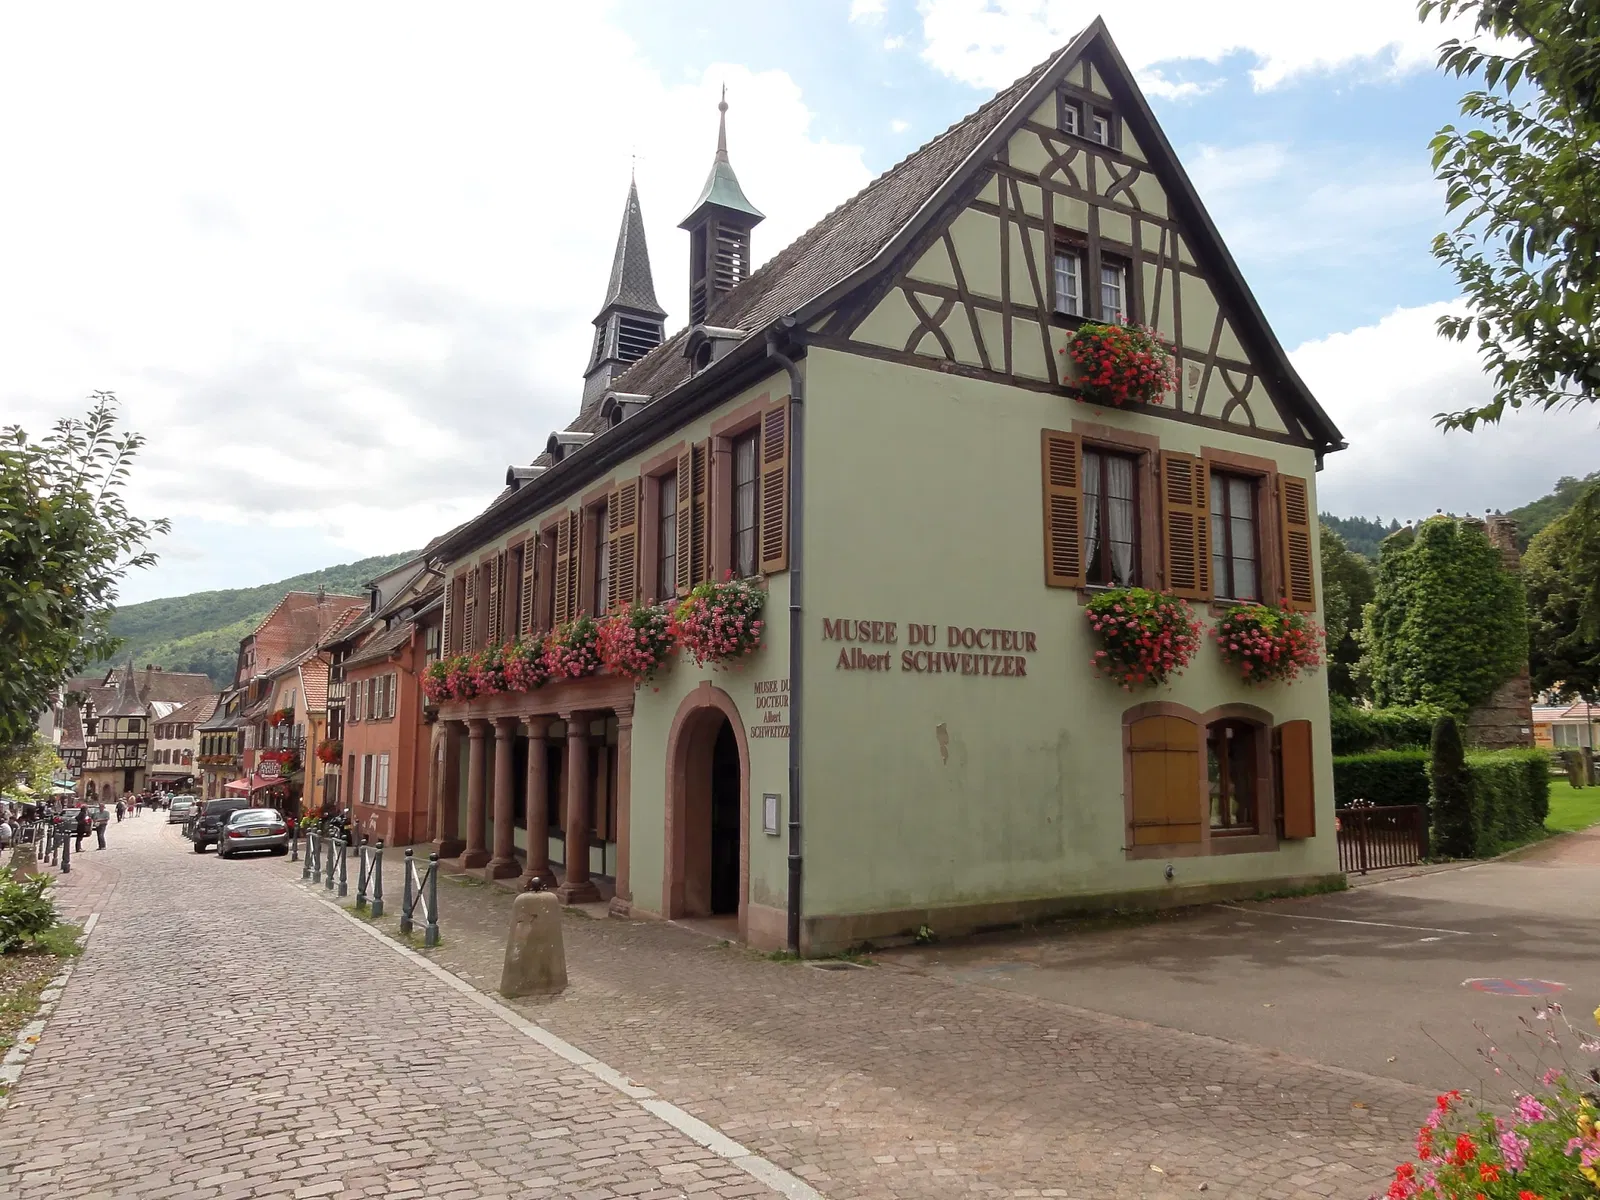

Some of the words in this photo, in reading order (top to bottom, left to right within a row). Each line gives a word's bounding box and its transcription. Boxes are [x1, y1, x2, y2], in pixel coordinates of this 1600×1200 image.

[822, 617, 899, 645] MUSEE
[907, 623, 937, 646] DU
[947, 626, 1038, 652] DOCTEUR
[836, 647, 892, 672] Albert
[901, 649, 1027, 677] SCHWEITZER
[754, 680, 778, 694] MUSEE
[780, 679, 791, 692] DU
[756, 694, 789, 709] DOCTEUR
[763, 710, 781, 723] Albert
[750, 725, 790, 738] SCHWEITZE
